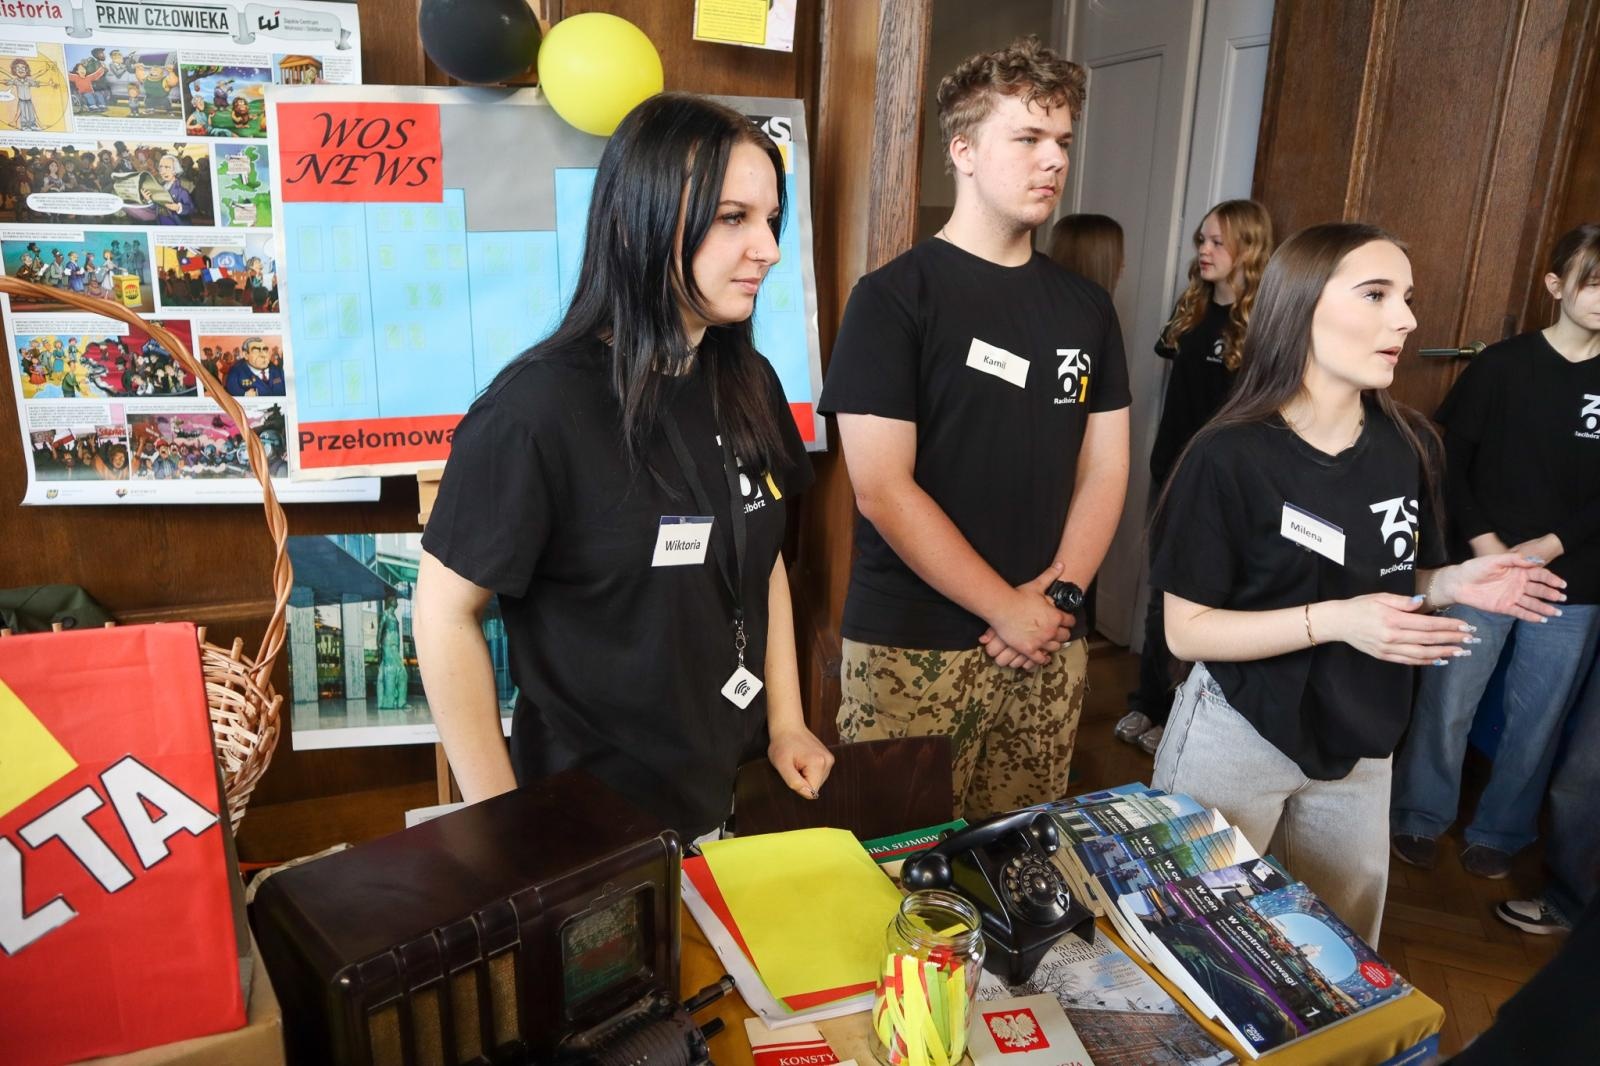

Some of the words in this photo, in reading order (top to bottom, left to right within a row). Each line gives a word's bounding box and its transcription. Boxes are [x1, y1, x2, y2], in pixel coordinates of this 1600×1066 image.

[0, 0, 63, 19] istoria
[96, 5, 139, 25] PRAW
[144, 8, 229, 30] CZŁOWIEKA
[313, 112, 416, 150] WOS
[285, 151, 437, 187] NEWS
[983, 355, 1007, 370] Kamil
[1290, 521, 1323, 543] Milena
[665, 539, 701, 551] Wiktoria
[891, 832, 948, 849] SEJMOW
[1228, 915, 1239, 925] W
[1236, 925, 1271, 959] centrum
[1270, 959, 1299, 987] uwagi
[1306, 1006, 1320, 1018] 1
[779, 1053, 835, 1066] KONSTY
